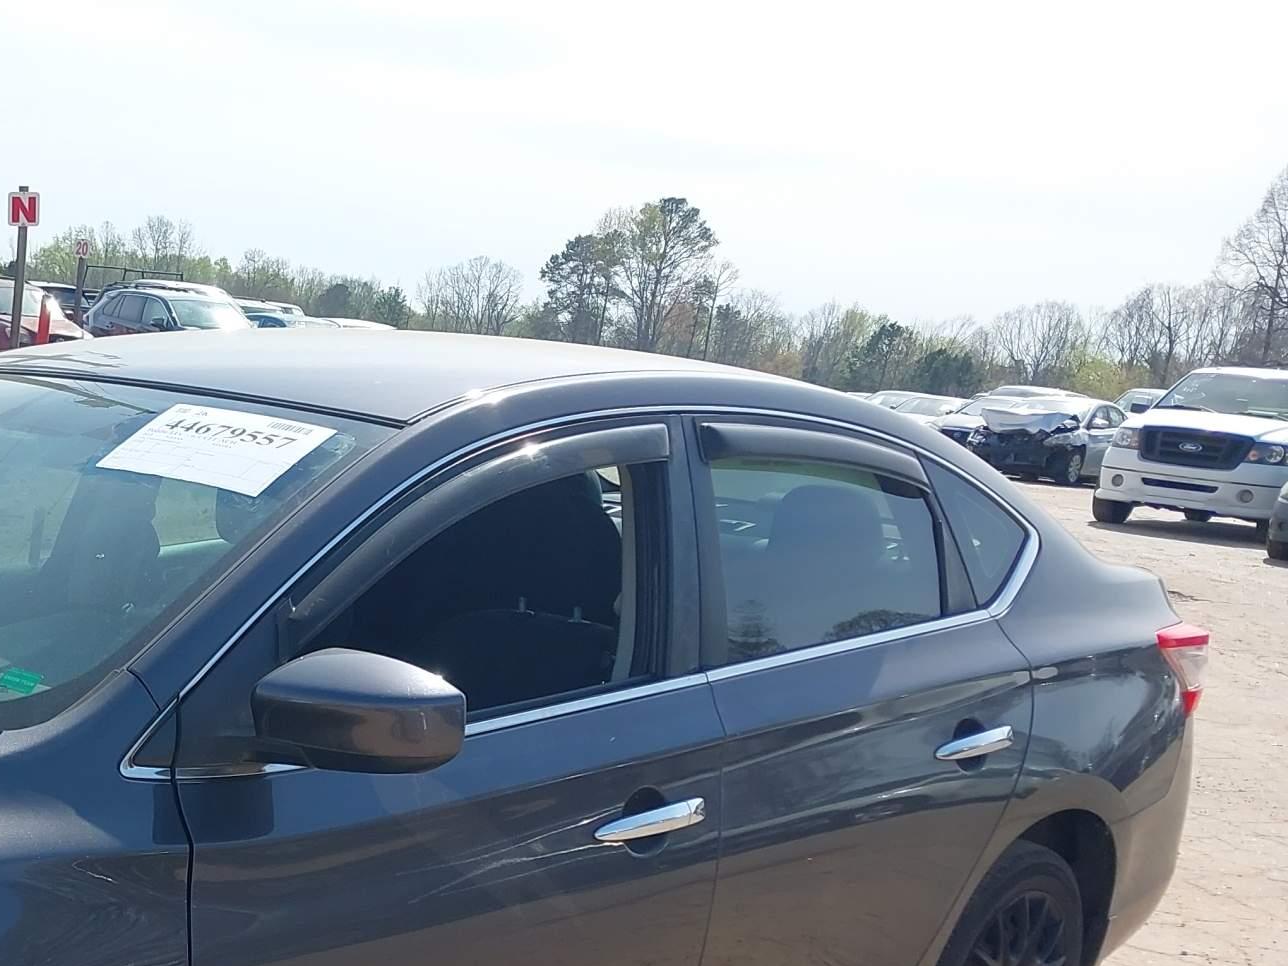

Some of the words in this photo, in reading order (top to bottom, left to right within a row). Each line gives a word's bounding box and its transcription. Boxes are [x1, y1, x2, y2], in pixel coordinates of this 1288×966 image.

[12, 197, 36, 223] N
[76, 241, 88, 257] 20
[165, 418, 298, 449] 44679557
